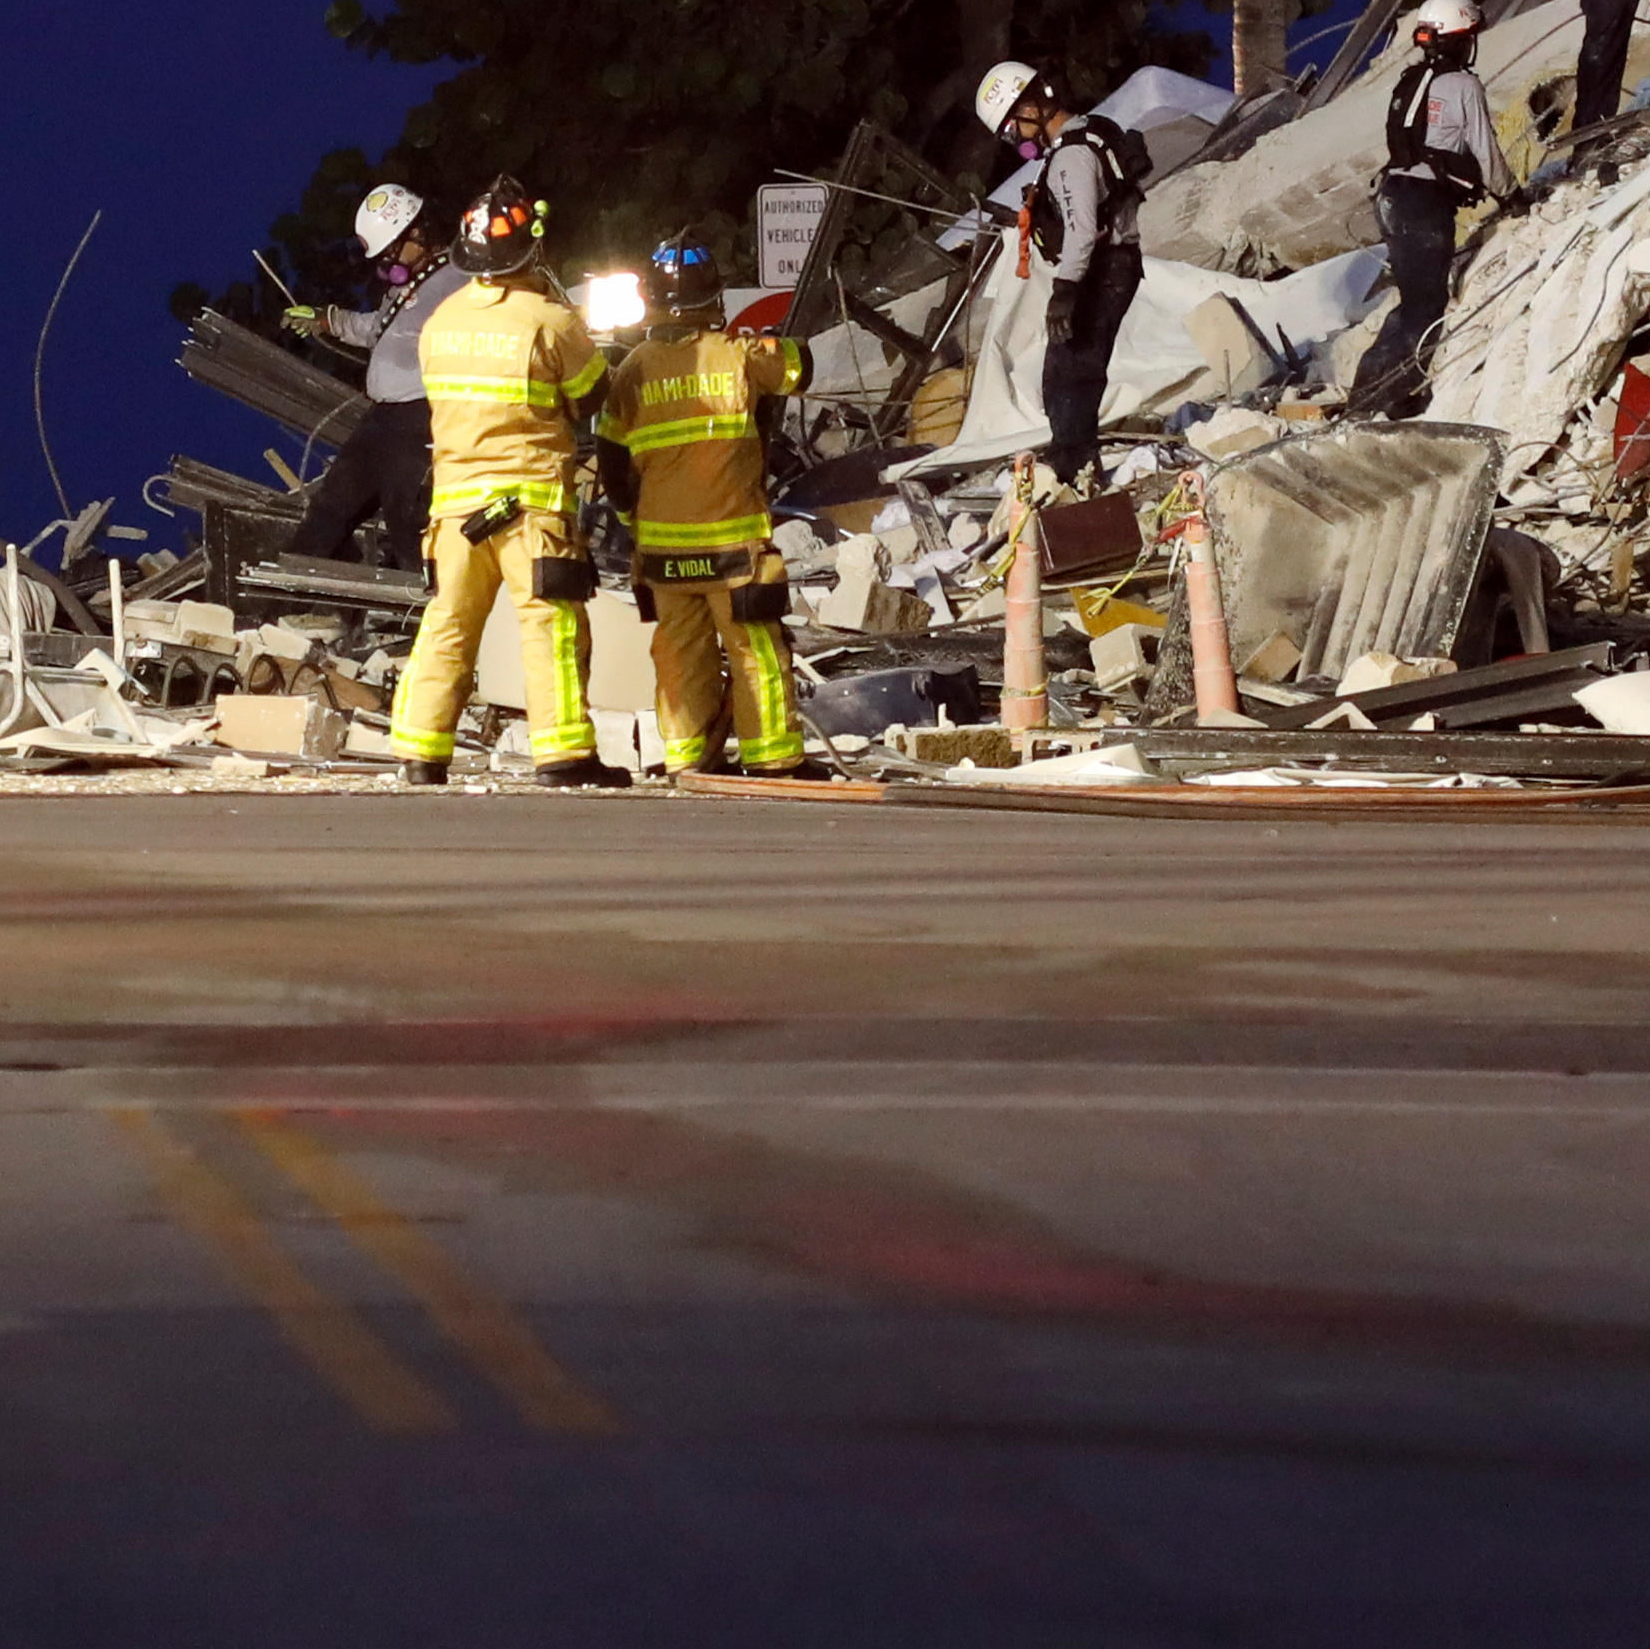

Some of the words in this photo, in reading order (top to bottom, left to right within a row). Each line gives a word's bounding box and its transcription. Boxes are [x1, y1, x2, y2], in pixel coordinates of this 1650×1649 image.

[764, 200, 823, 214] AUTHORIZED
[767, 229, 814, 243] VEHICLE
[778, 259, 806, 274] ONL
[677, 558, 715, 578] VIDAL
